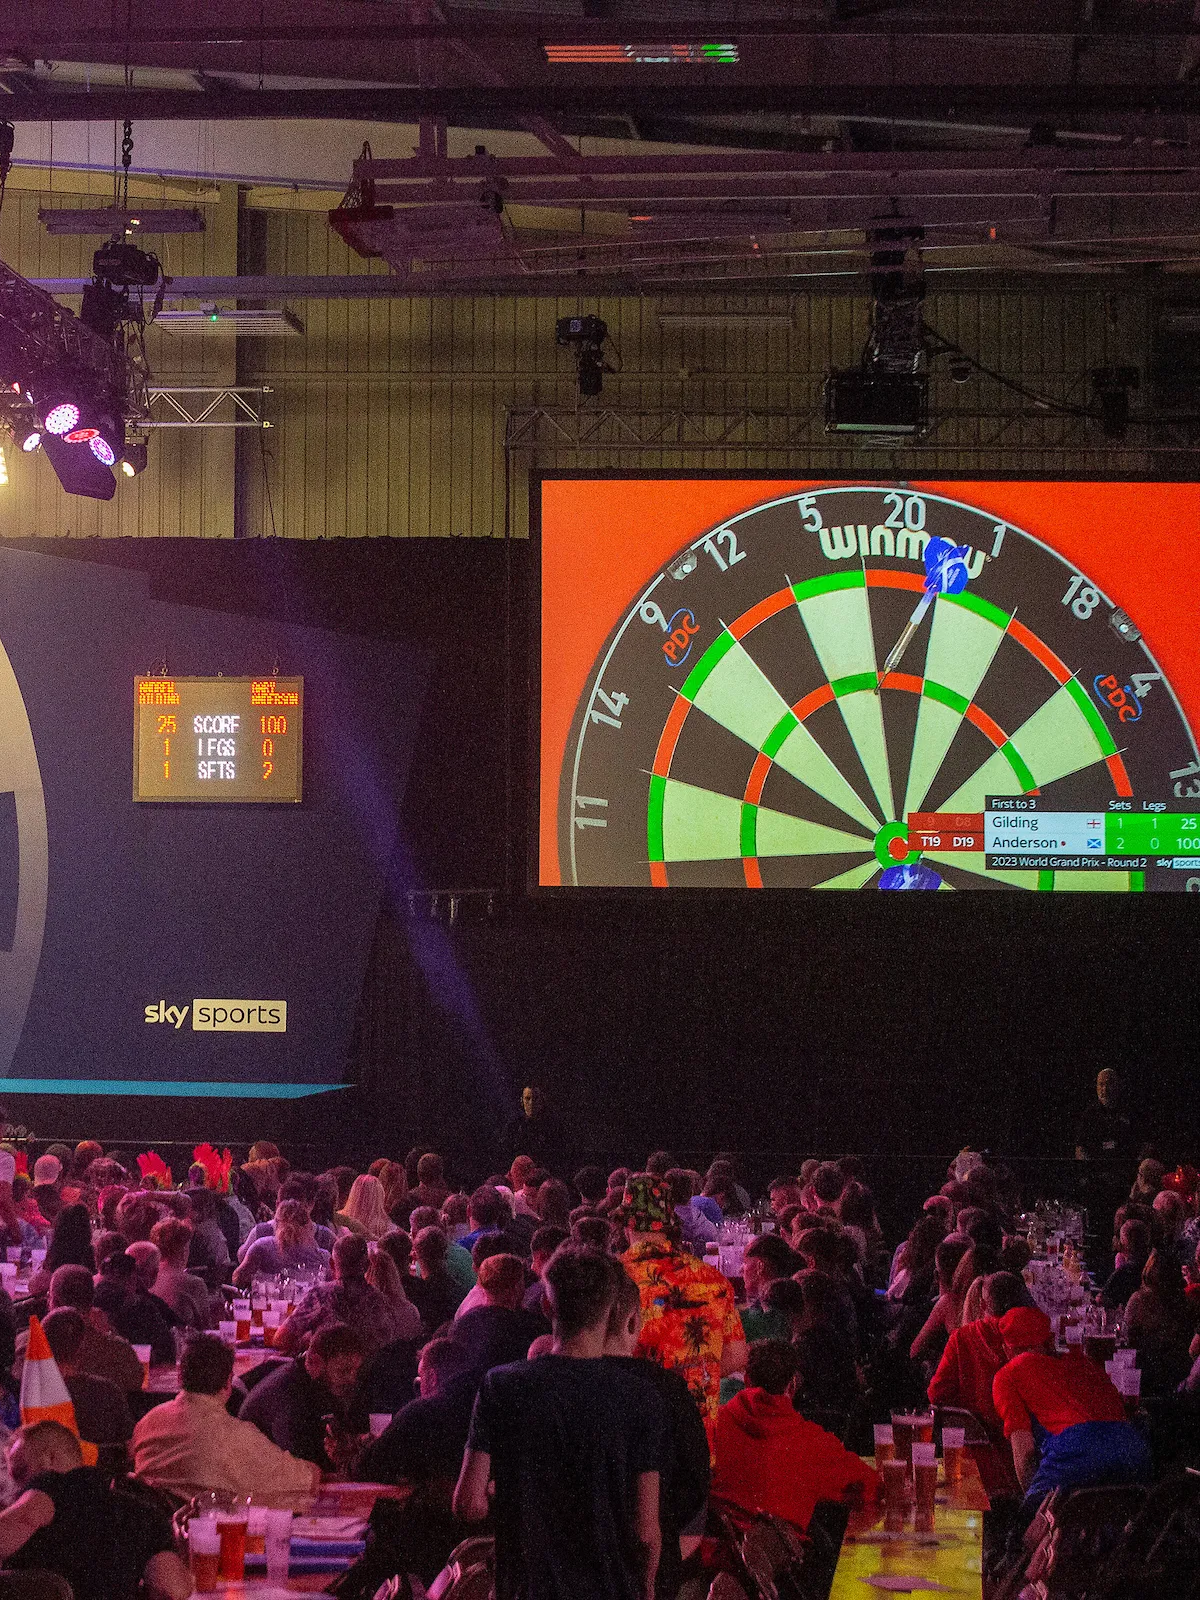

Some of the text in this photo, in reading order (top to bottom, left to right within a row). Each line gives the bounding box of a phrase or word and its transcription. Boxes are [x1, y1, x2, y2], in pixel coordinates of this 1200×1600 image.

[798, 496, 823, 533] 5
[883, 493, 927, 531] 20
[704, 529, 747, 572] 12
[819, 524, 987, 580] winmu
[991, 524, 1006, 557] 1
[1061, 575, 1100, 620] 18
[639, 601, 671, 632] 9
[662, 613, 700, 661] PDC
[1100, 675, 1136, 723] PDC
[1130, 672, 1163, 698] 4
[591, 688, 629, 729] 14
[260, 715, 287, 734] 100
[163, 738, 170, 756] 1
[262, 738, 274, 756] 0
[163, 760, 170, 779] 1
[575, 795, 609, 828] 11
[992, 799, 1036, 809] First to 3
[1108, 800, 1166, 812] Sets Legs
[992, 816, 1197, 831] Gilding 1 1 25
[921, 836, 974, 847] T19 D19
[992, 836, 1200, 849] Anderson 2 0 100
[992, 857, 1018, 866] 2023
[1019, 857, 1049, 867] World
[1050, 857, 1079, 867] Grand
[1081, 857, 1099, 867] Prix
[1107, 857, 1139, 867] Round
[1140, 857, 1147, 867] 2
[1156, 858, 1172, 868] sky
[144, 1000, 281, 1029] sky sports
